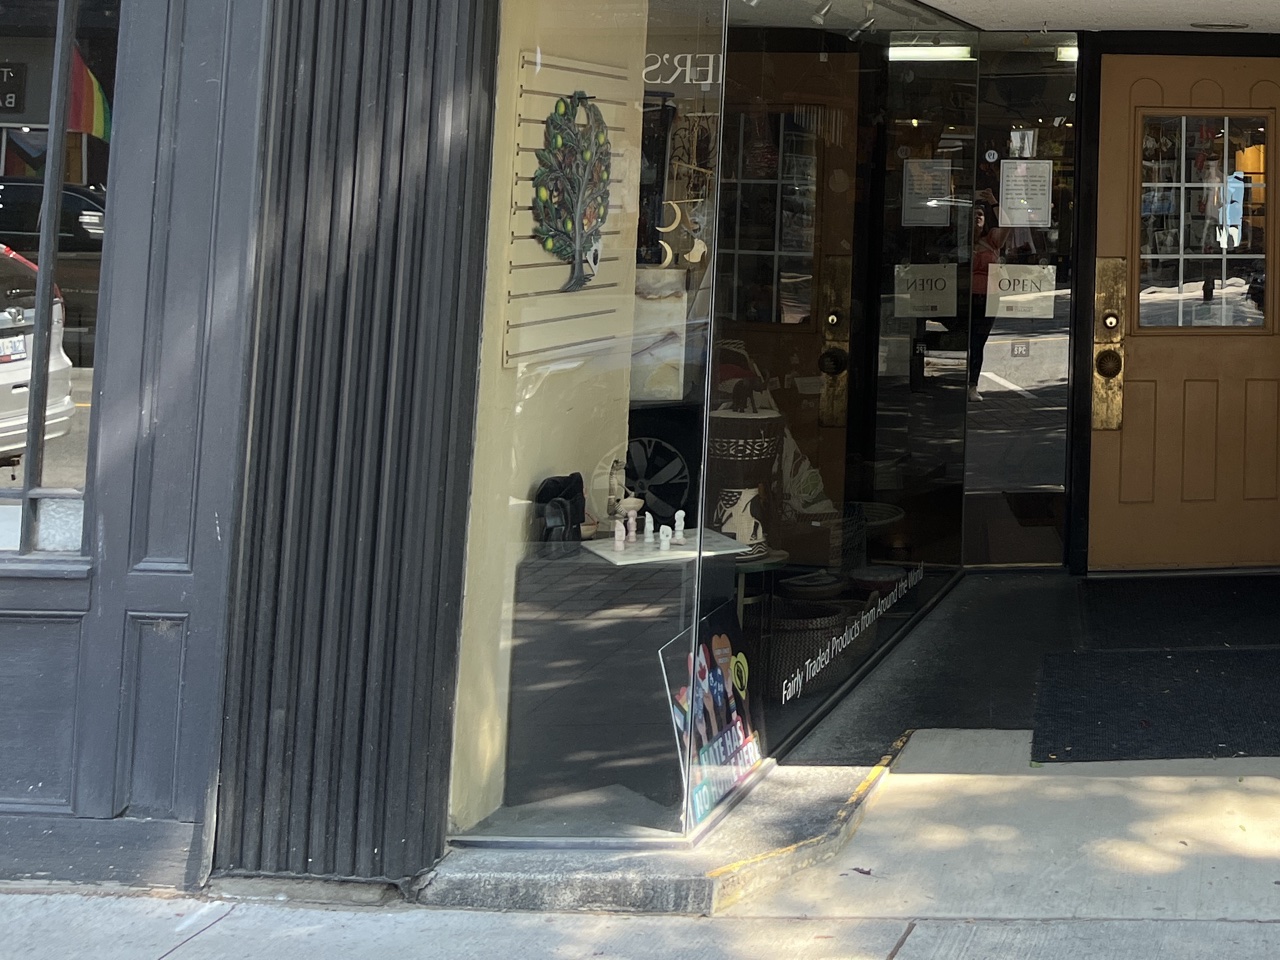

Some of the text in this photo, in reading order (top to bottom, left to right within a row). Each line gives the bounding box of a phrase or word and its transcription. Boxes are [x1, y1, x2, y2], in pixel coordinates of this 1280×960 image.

[998, 278, 1042, 292] OPEN
[782, 560, 924, 705] Fairly Traded Products from Around the World
[695, 785, 710, 820] NO
[737, 739, 761, 777] HERE
[700, 721, 744, 779] HATE HAS
